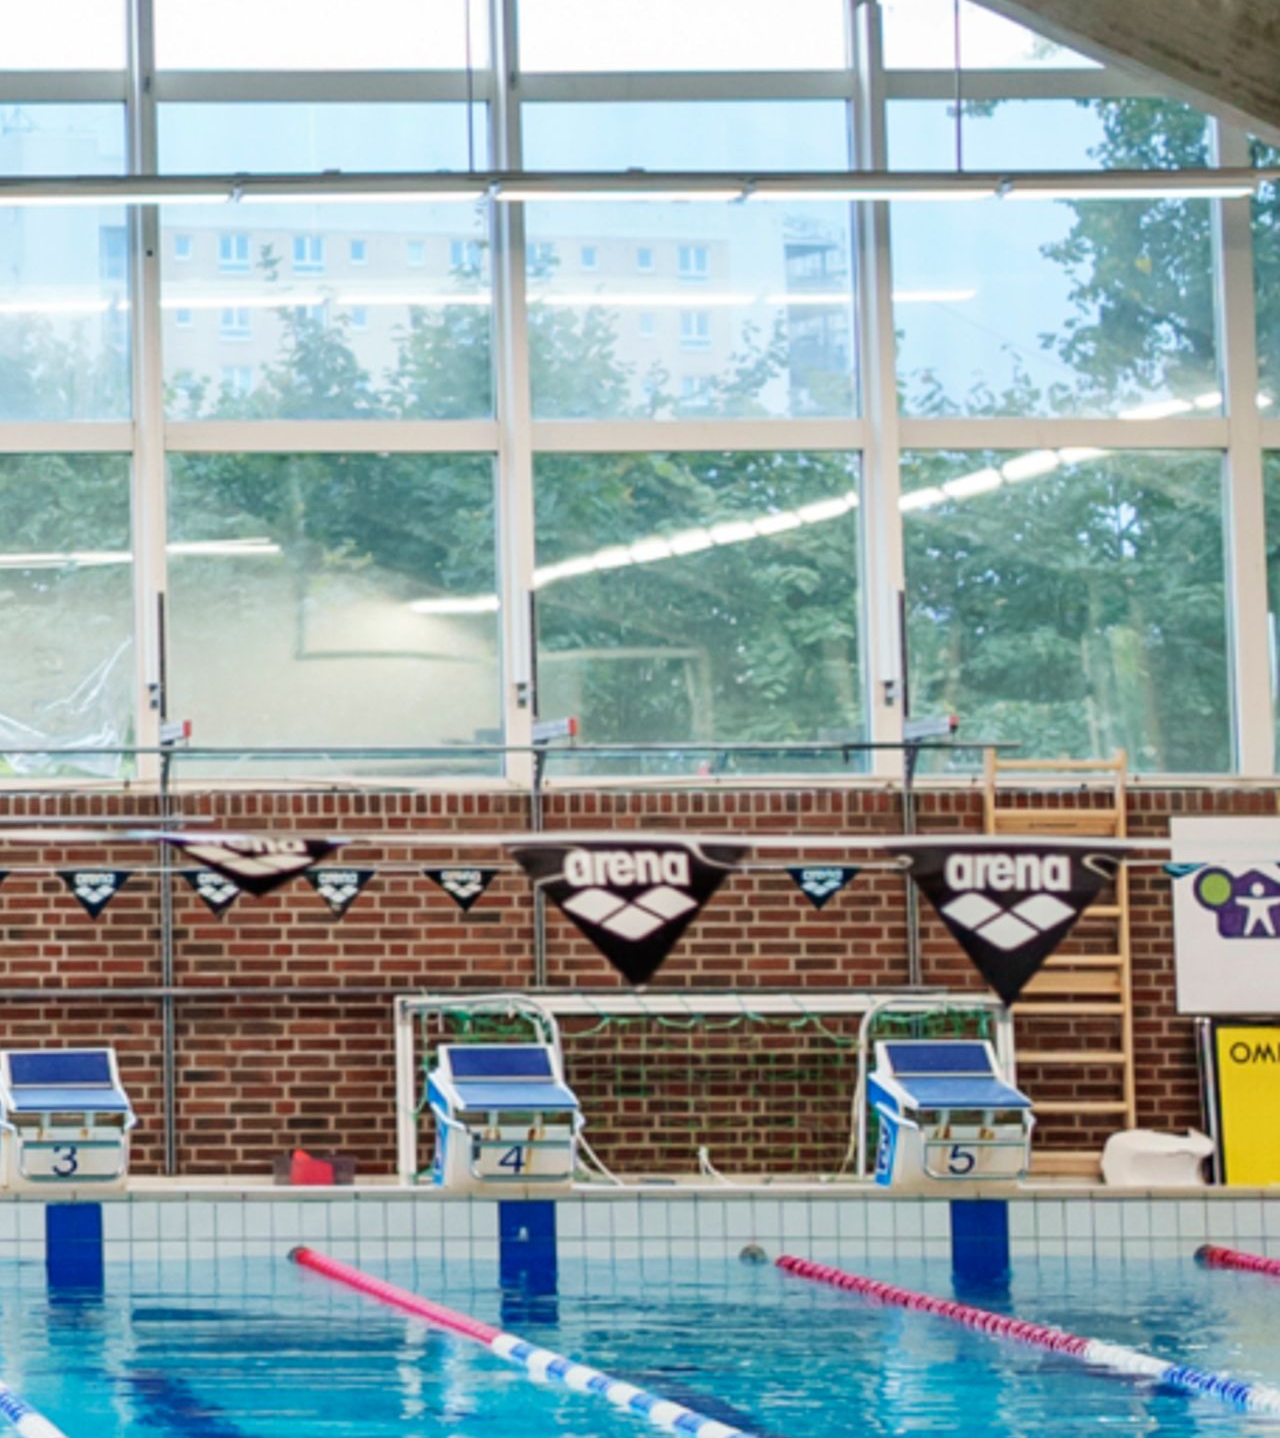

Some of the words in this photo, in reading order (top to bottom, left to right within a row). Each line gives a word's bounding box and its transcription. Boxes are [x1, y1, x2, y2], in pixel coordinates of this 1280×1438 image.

[562, 850, 689, 886] arena
[945, 853, 1071, 891] arena
[1229, 1041, 1280, 1064] OM
[52, 1146, 78, 1178] 3
[498, 1145, 525, 1175] 4
[948, 1144, 976, 1175] 5
